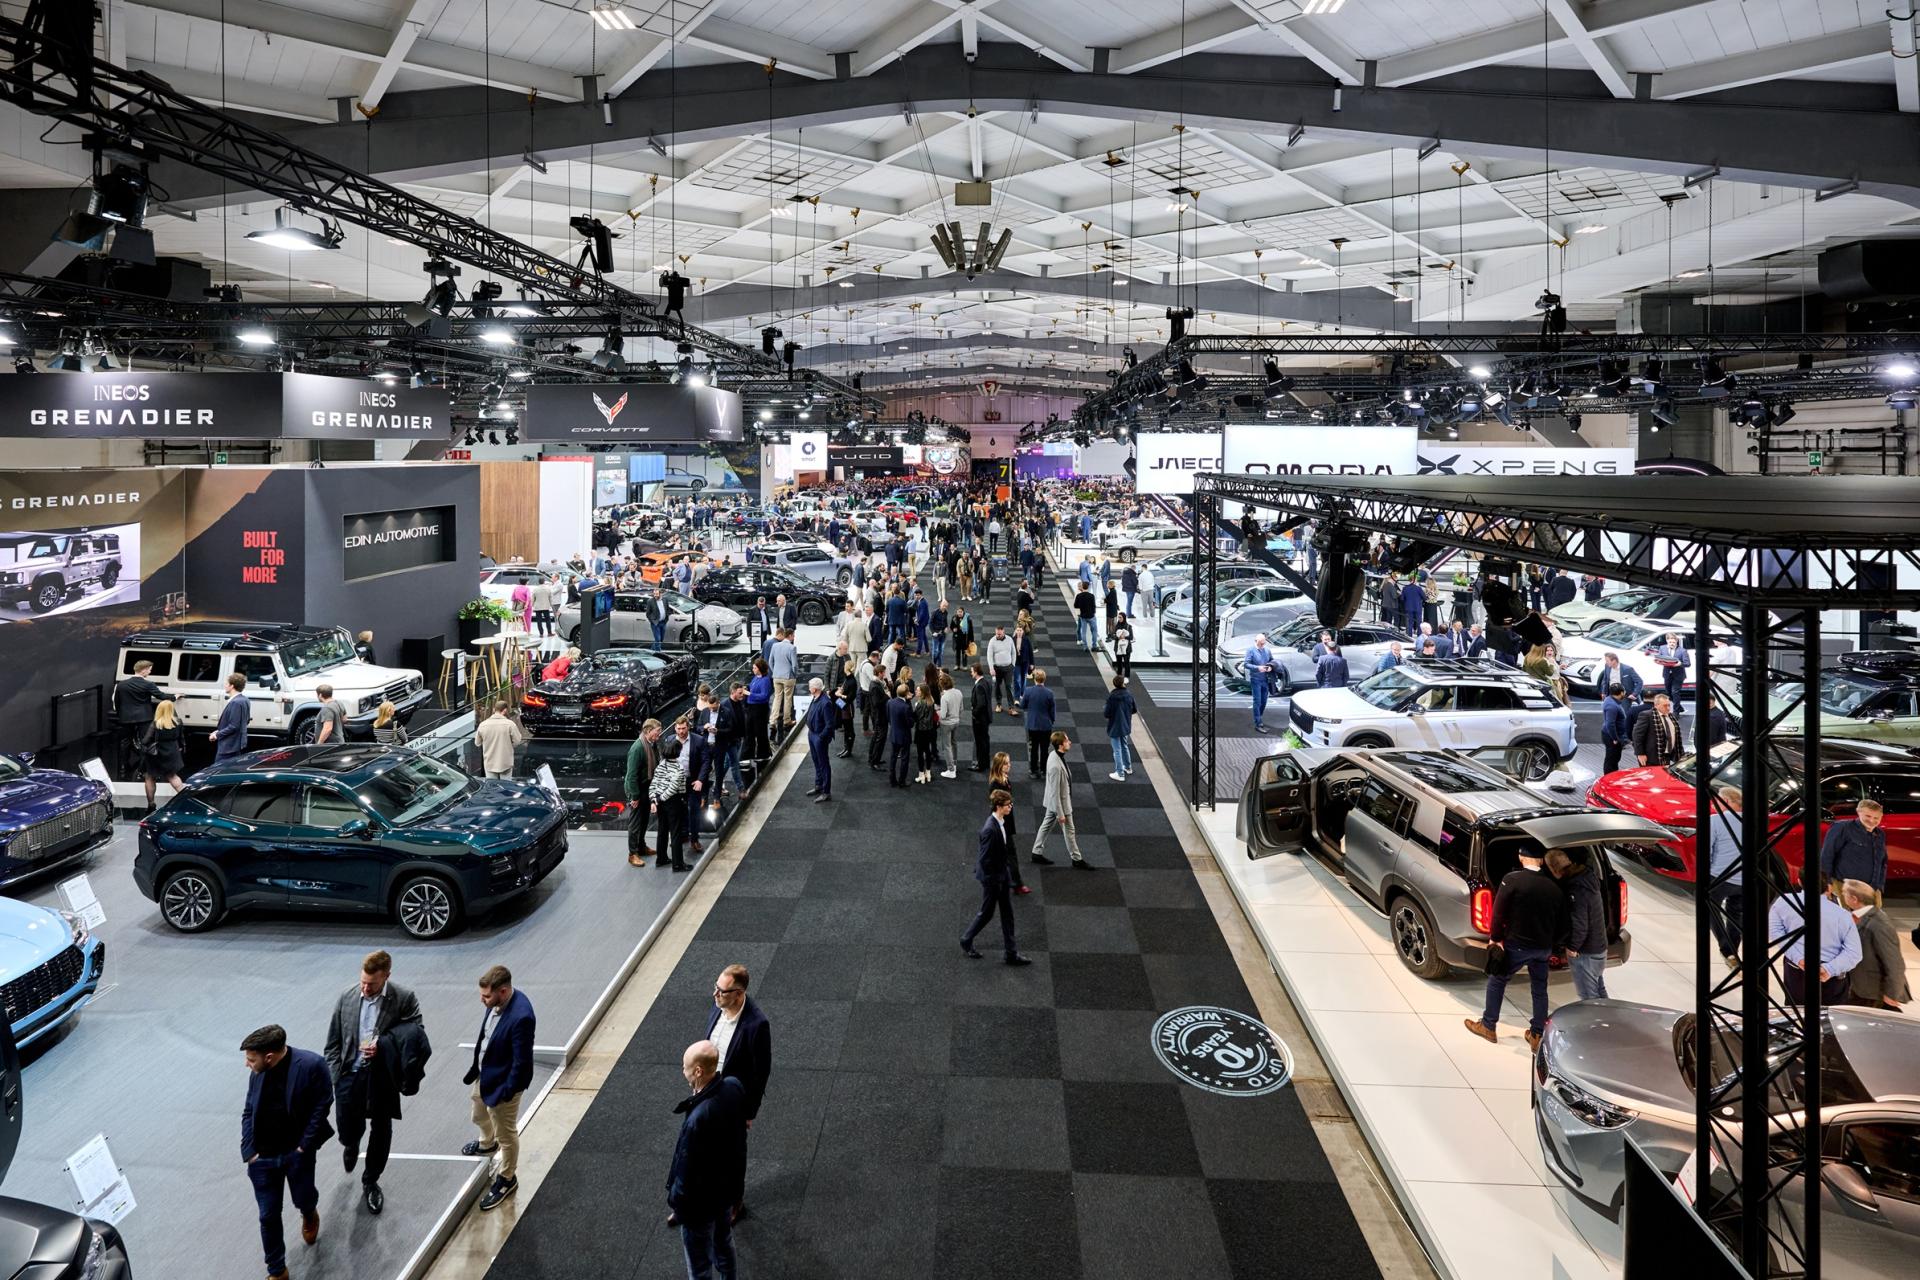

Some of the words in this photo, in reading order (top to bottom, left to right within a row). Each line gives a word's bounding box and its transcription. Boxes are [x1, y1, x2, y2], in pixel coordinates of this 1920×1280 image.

[93, 385, 150, 401] INEOS
[359, 391, 397, 408] INEOS
[30, 409, 214, 426] GRENADIER
[312, 411, 433, 429] GRENADIER
[999, 465, 1008, 478] 7
[1472, 460, 1617, 475] XPENG
[12, 492, 140, 509] GRENADIER
[243, 531, 277, 548] BUILT
[344, 533, 372, 548] EDIN
[374, 524, 439, 544] AUTOMOTIVE
[260, 549, 285, 566] FOR
[242, 566, 277, 583] MORE
[1160, 1012, 1222, 1054] WARRANTY
[1191, 1028, 1234, 1059] YEARS
[1213, 1041, 1255, 1069] 10
[1269, 1058, 1284, 1076] UP
[1248, 1075, 1274, 1088] TO
